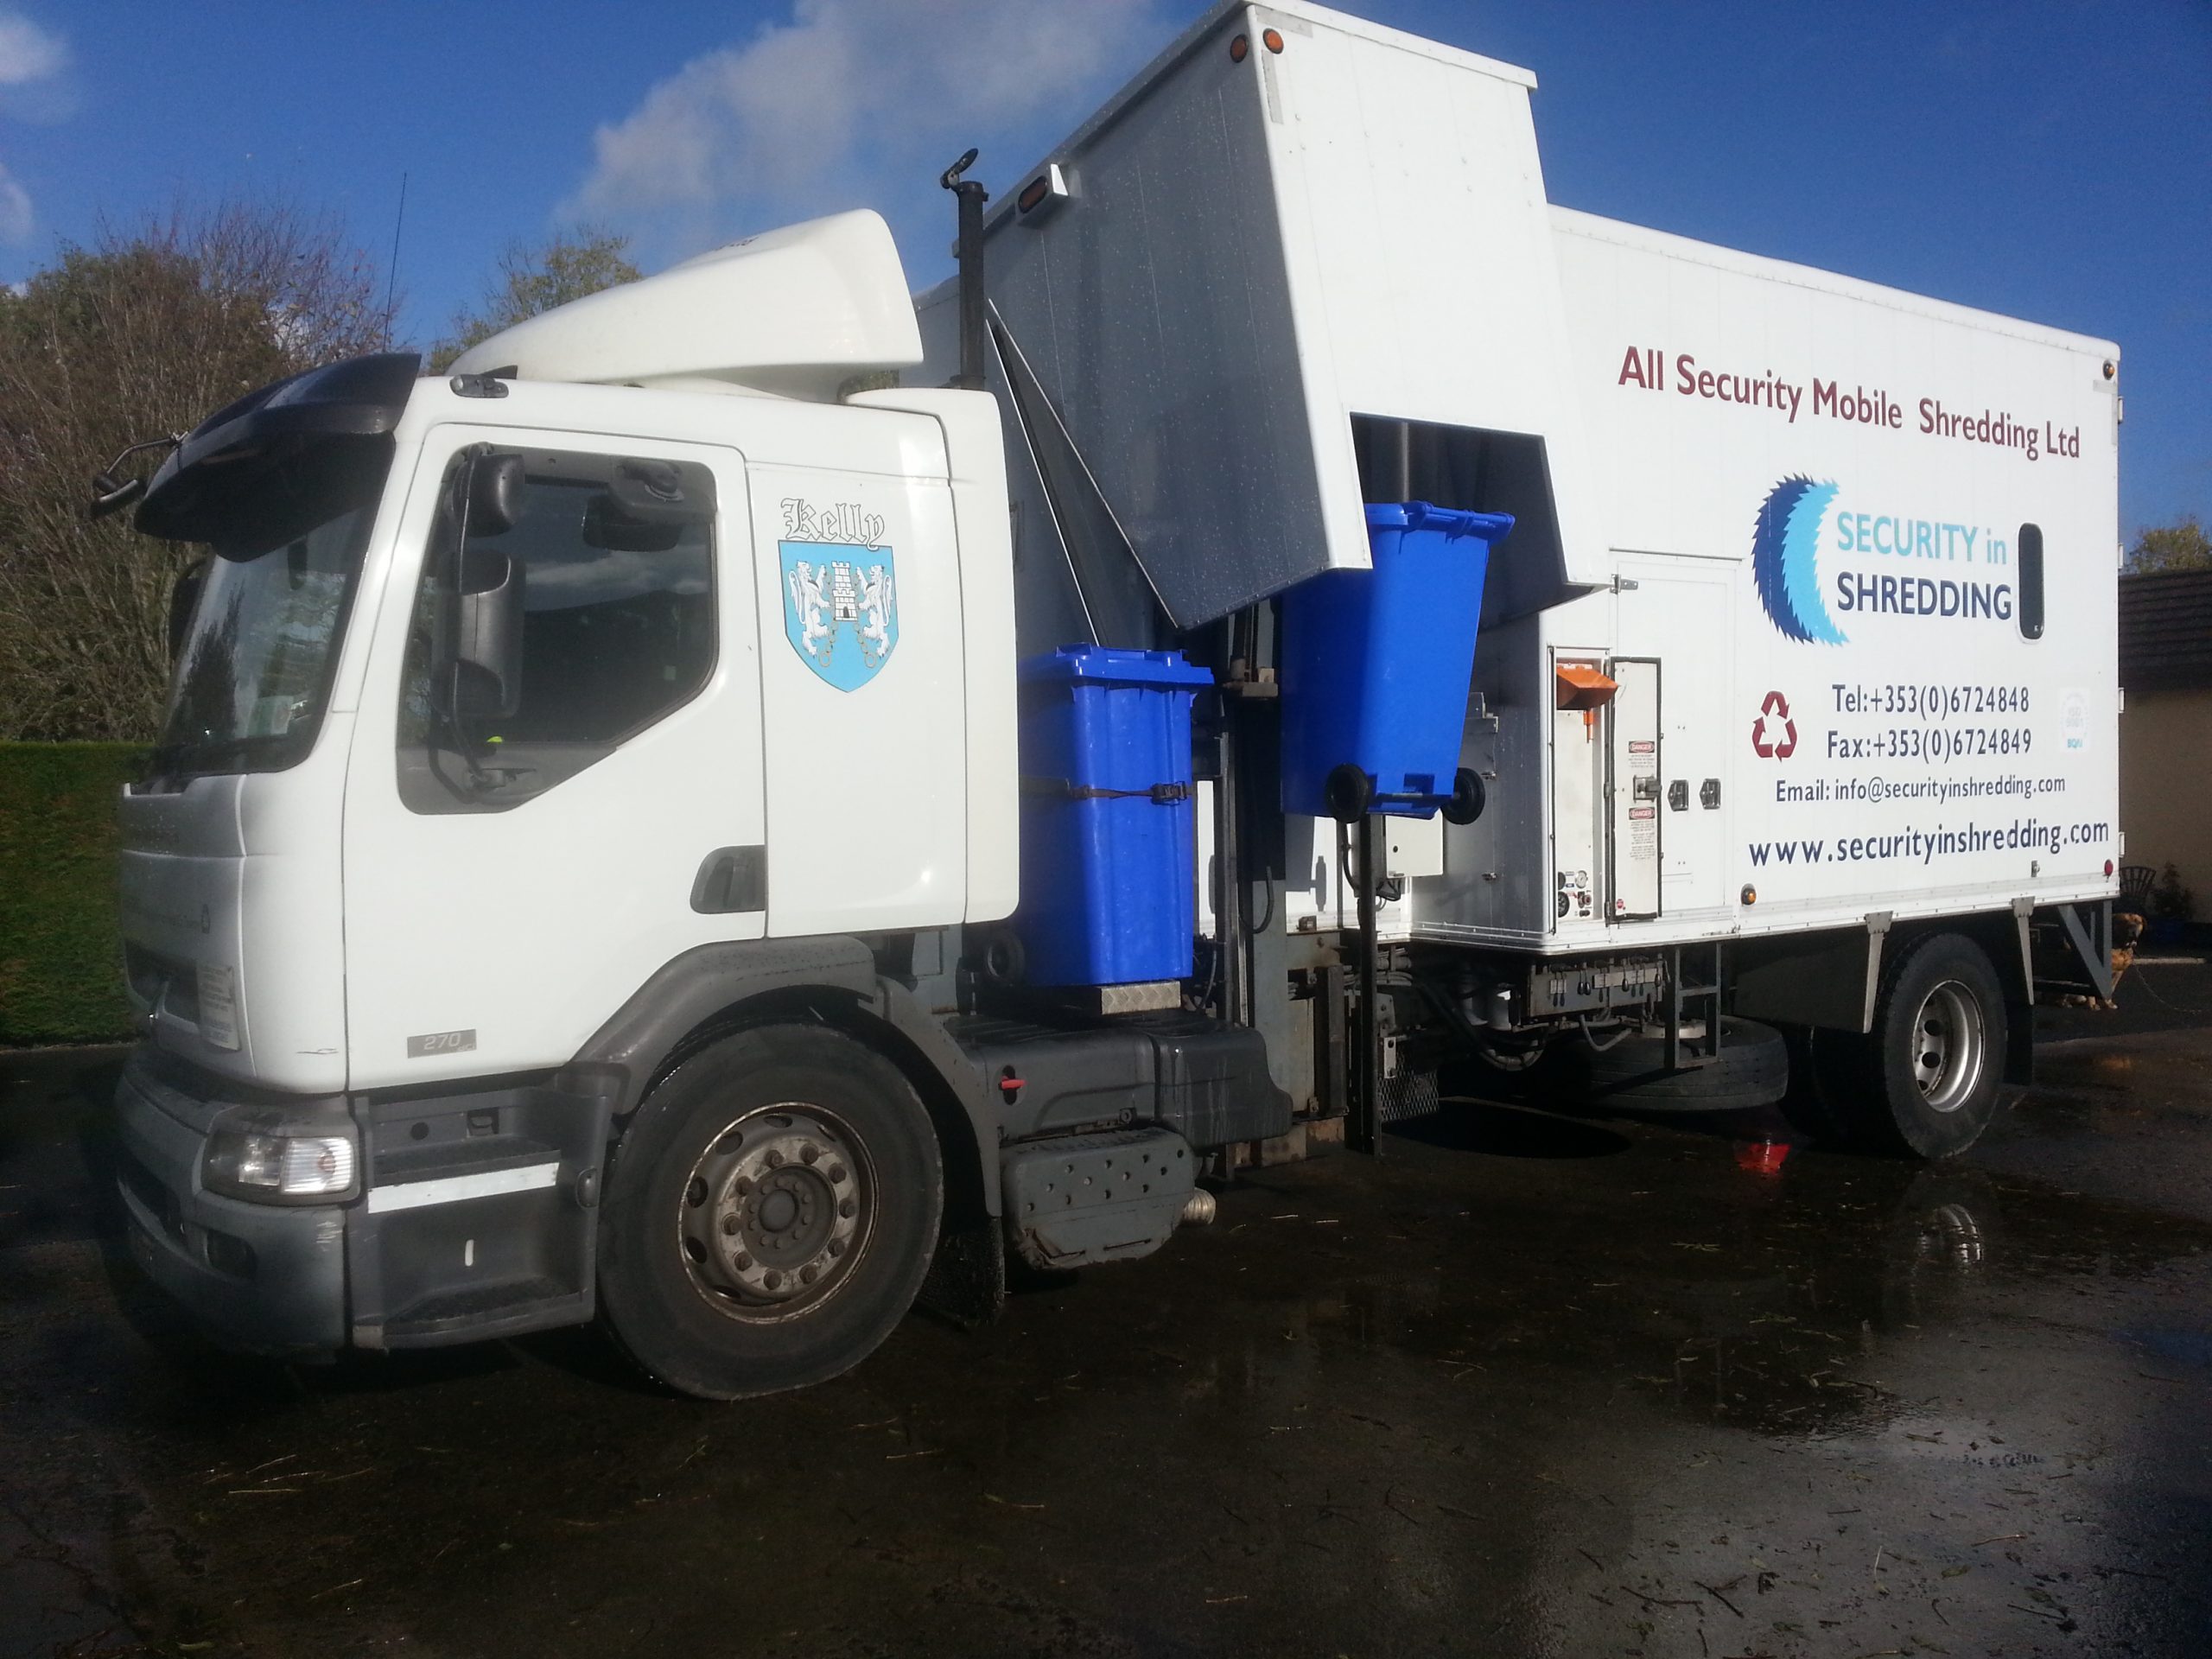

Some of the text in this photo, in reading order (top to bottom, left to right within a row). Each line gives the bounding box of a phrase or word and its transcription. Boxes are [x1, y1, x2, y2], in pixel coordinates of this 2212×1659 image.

[1618, 346, 2079, 461] All Security Mobile Shredding Ltd
[780, 498, 885, 550] Kelly
[1838, 512, 2005, 564] SECURITY in
[1838, 572, 2011, 620] SHREDDING
[1832, 684, 2030, 721] Tel:+353(0)6724848
[1828, 728, 2031, 764] Fax:+353(0)6724849
[1776, 775, 2064, 804] Email: info@securityinshredding.com
[1748, 819, 2109, 867] www.securityinshredding.com
[423, 1033, 461, 1051] 270
